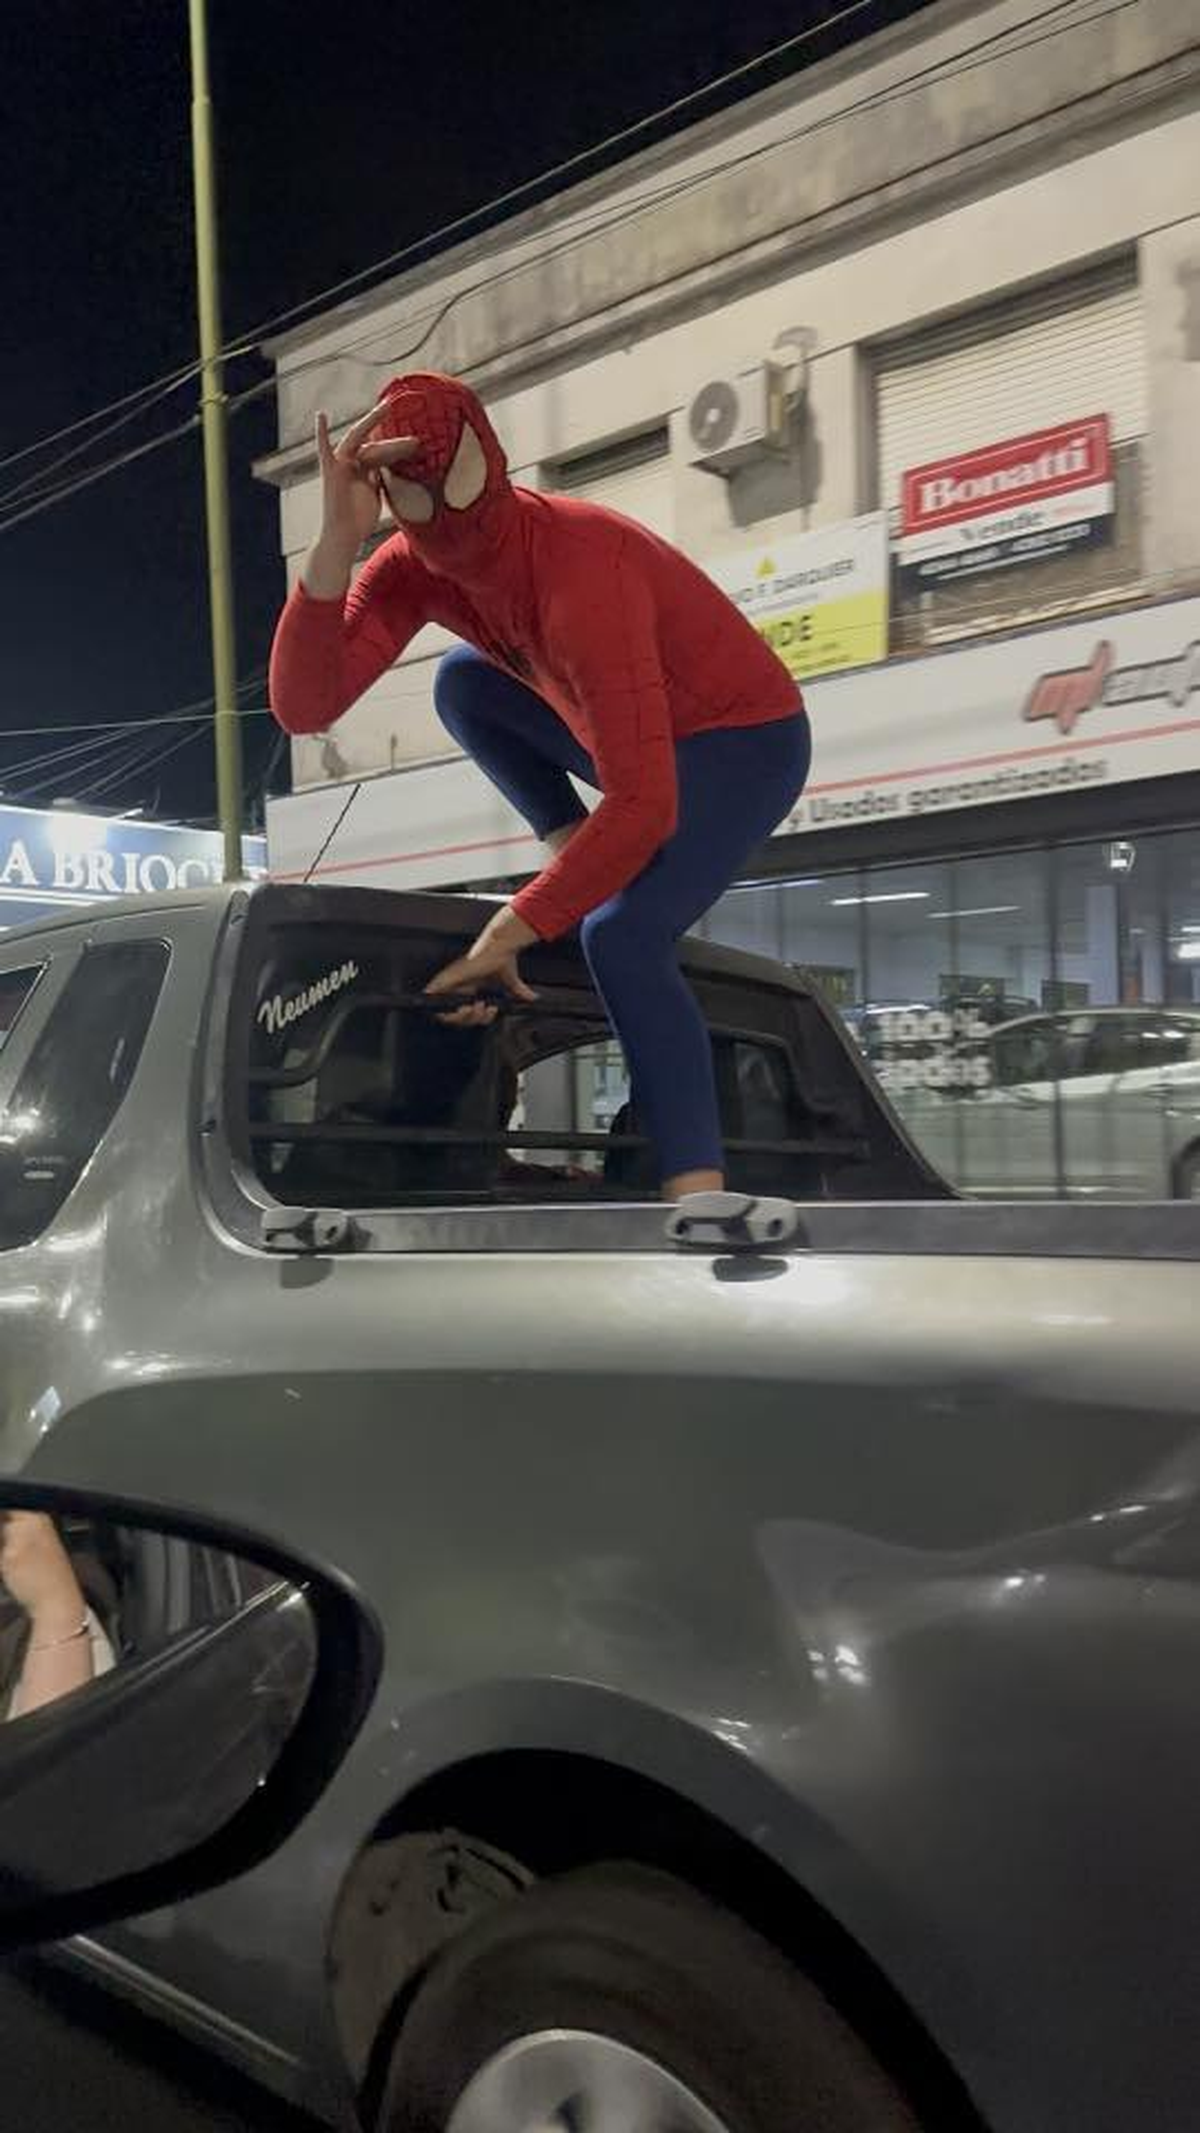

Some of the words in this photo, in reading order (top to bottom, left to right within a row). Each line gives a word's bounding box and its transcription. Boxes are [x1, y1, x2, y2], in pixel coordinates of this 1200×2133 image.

[920, 437, 1089, 514] Bonatti
[809, 790, 899, 823] Usados
[906, 757, 1106, 813] garantizados
[257, 960, 359, 1034] Neumen
